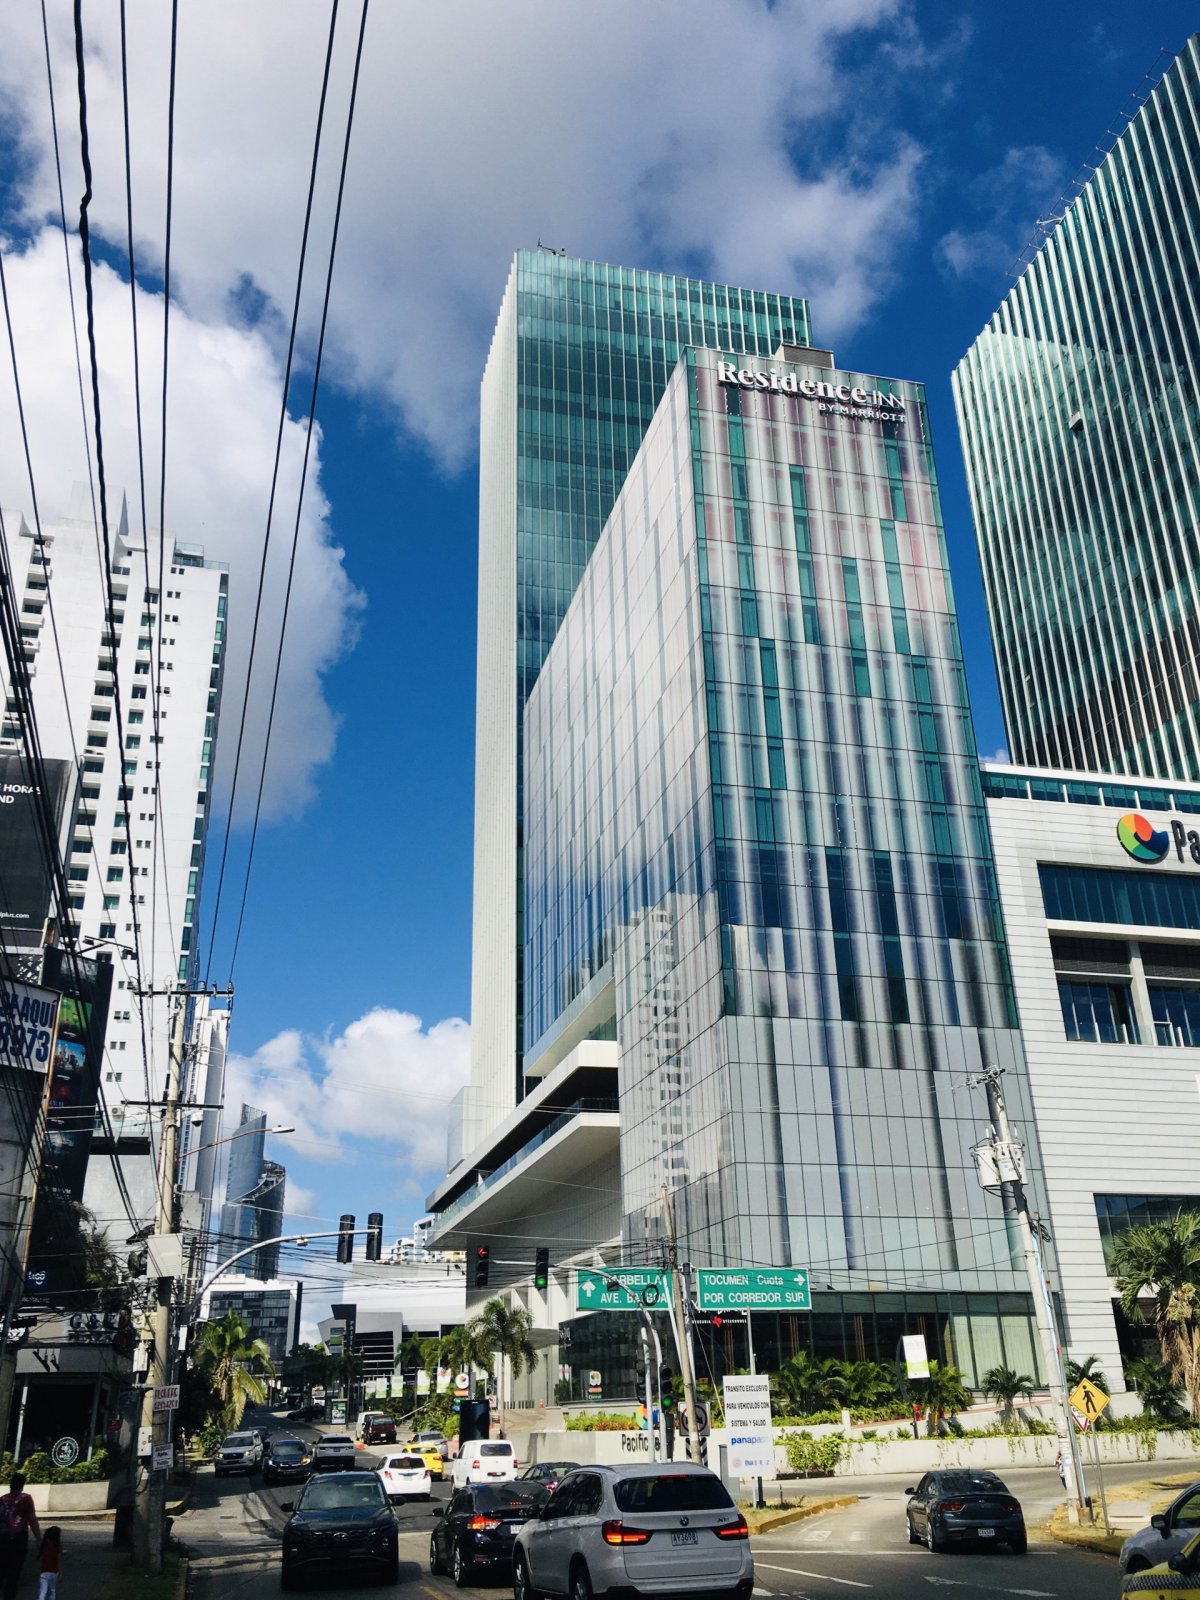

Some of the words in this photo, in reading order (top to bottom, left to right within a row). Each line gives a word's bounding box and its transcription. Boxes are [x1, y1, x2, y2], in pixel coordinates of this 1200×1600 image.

[717, 361, 867, 403] Residence
[819, 403, 834, 412] BY
[840, 406, 906, 423] MARRIOTT
[1170, 819, 1200, 866] Pa
[703, 1275, 749, 1285] TOCUMEN
[757, 1275, 784, 1285] Cuota
[600, 1293, 622, 1304] AVE.
[703, 1293, 725, 1303] POR
[728, 1292, 782, 1303] CORREDOR
[785, 1292, 805, 1302] SUR
[761, 1401, 769, 1409] CON
[621, 1433, 649, 1452] Pacific
[731, 1436, 767, 1446] panapa
